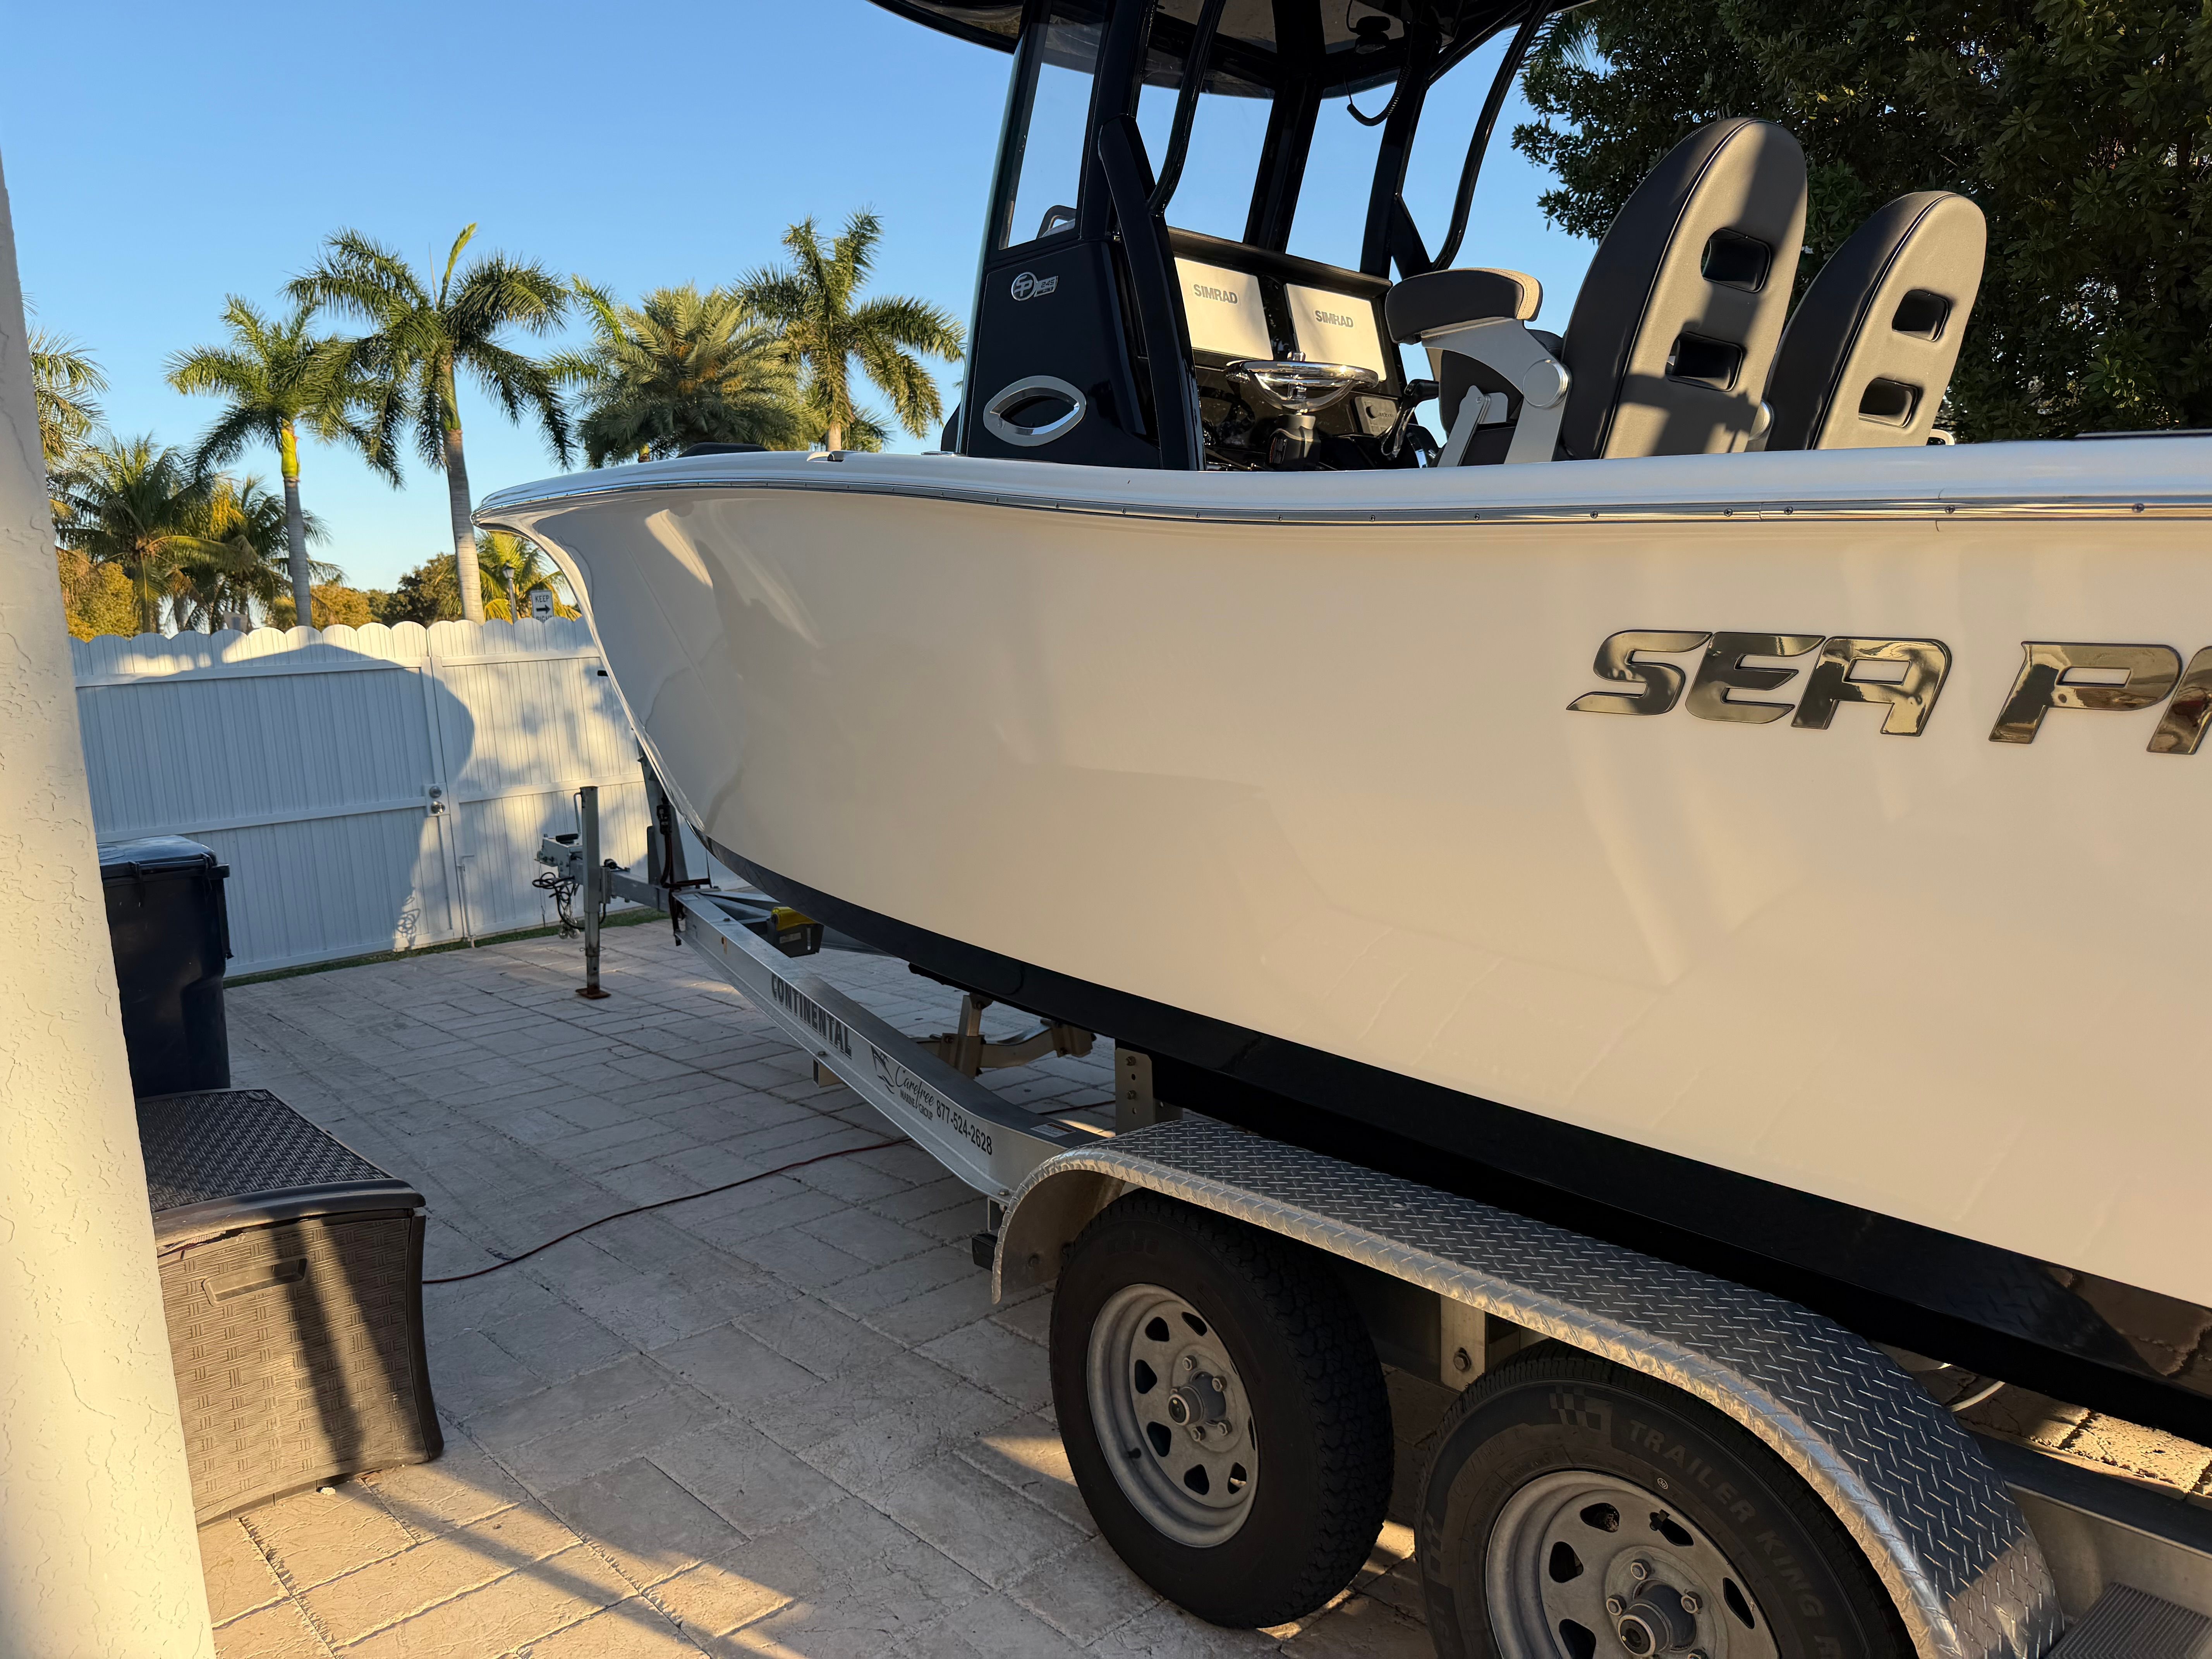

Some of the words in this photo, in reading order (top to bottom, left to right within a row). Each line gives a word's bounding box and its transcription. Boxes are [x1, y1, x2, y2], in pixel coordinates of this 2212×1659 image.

[1194, 284, 1238, 304] SIMRAD
[1315, 310, 1354, 328] SIMRAD
[1565, 629, 1953, 737] SEA
[771, 972, 852, 1060] CONTINENTAL
[895, 1065, 934, 1109] Carefree
[937, 1099, 992, 1155] 877-524-2628
[1629, 1419, 1757, 1523] TRAILER
[1755, 1530, 1825, 1618] KING
